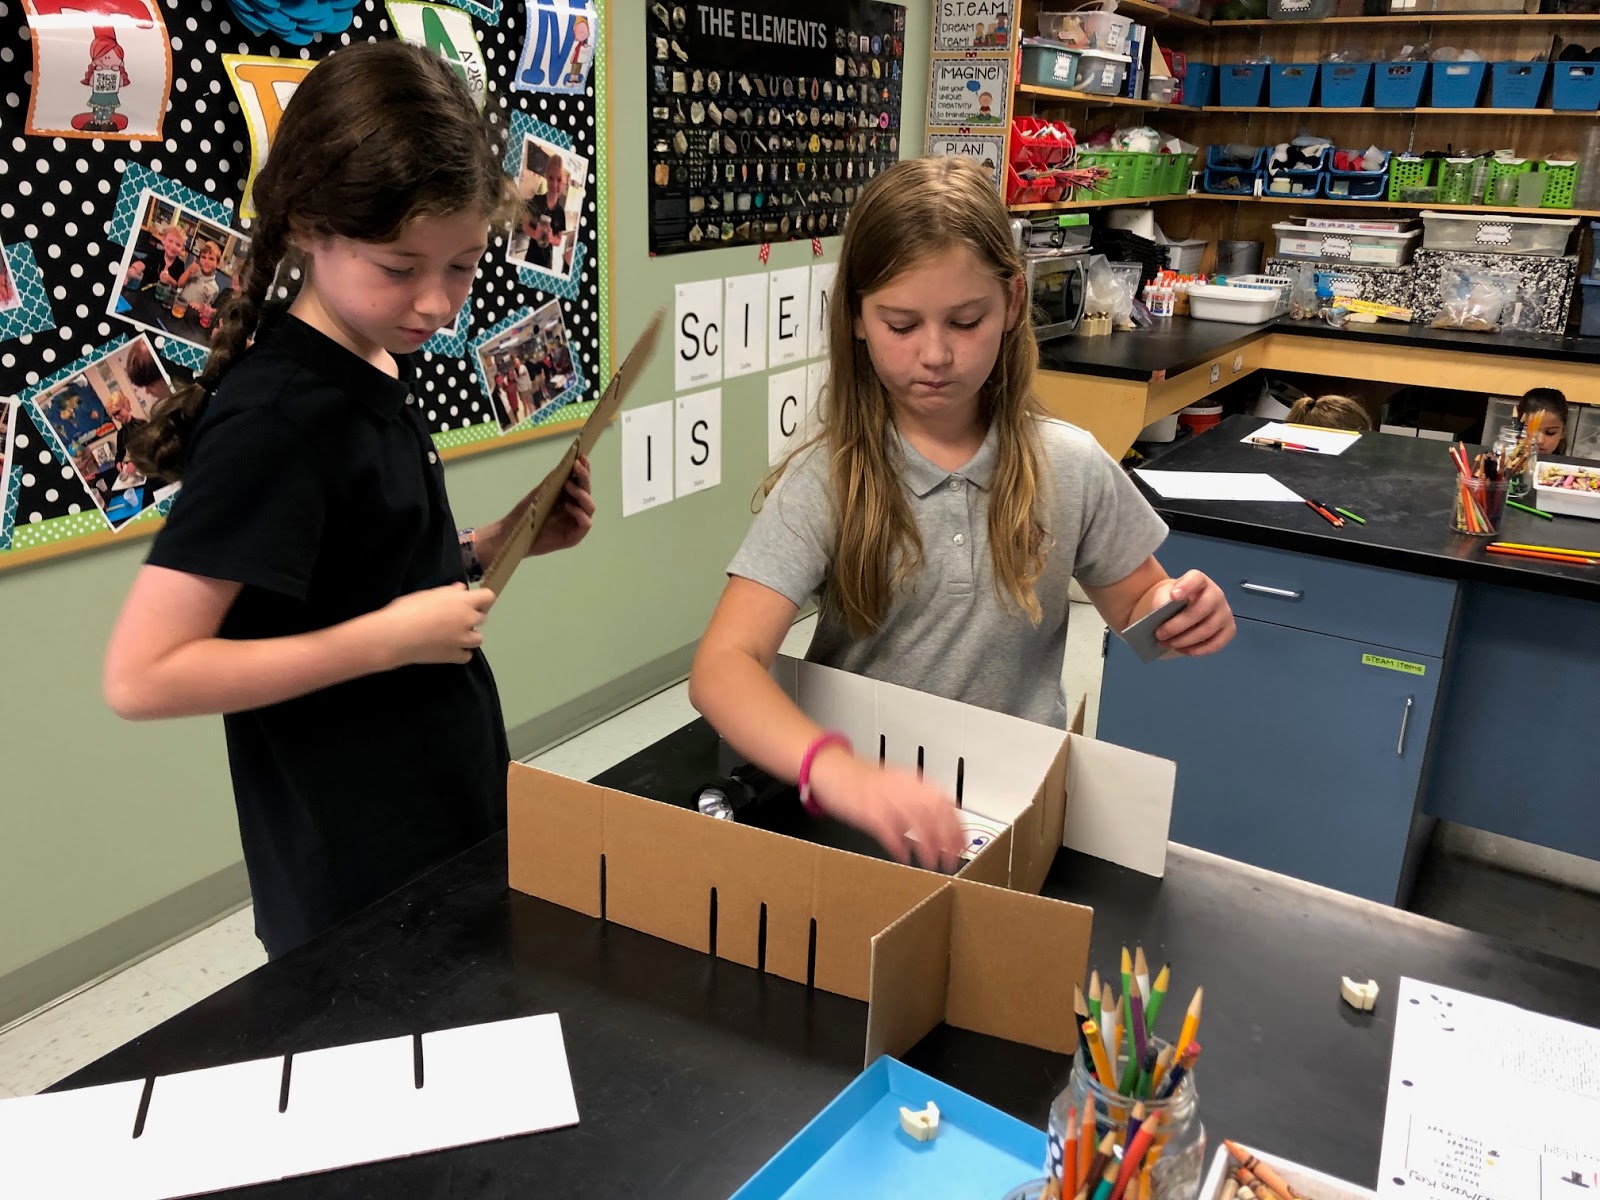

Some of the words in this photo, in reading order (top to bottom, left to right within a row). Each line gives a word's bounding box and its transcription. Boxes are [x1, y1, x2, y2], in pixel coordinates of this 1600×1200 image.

[697, 4, 735, 38] THE
[741, 11, 827, 49] ELEMENTS
[1365, 655, 1394, 666] STEAM
